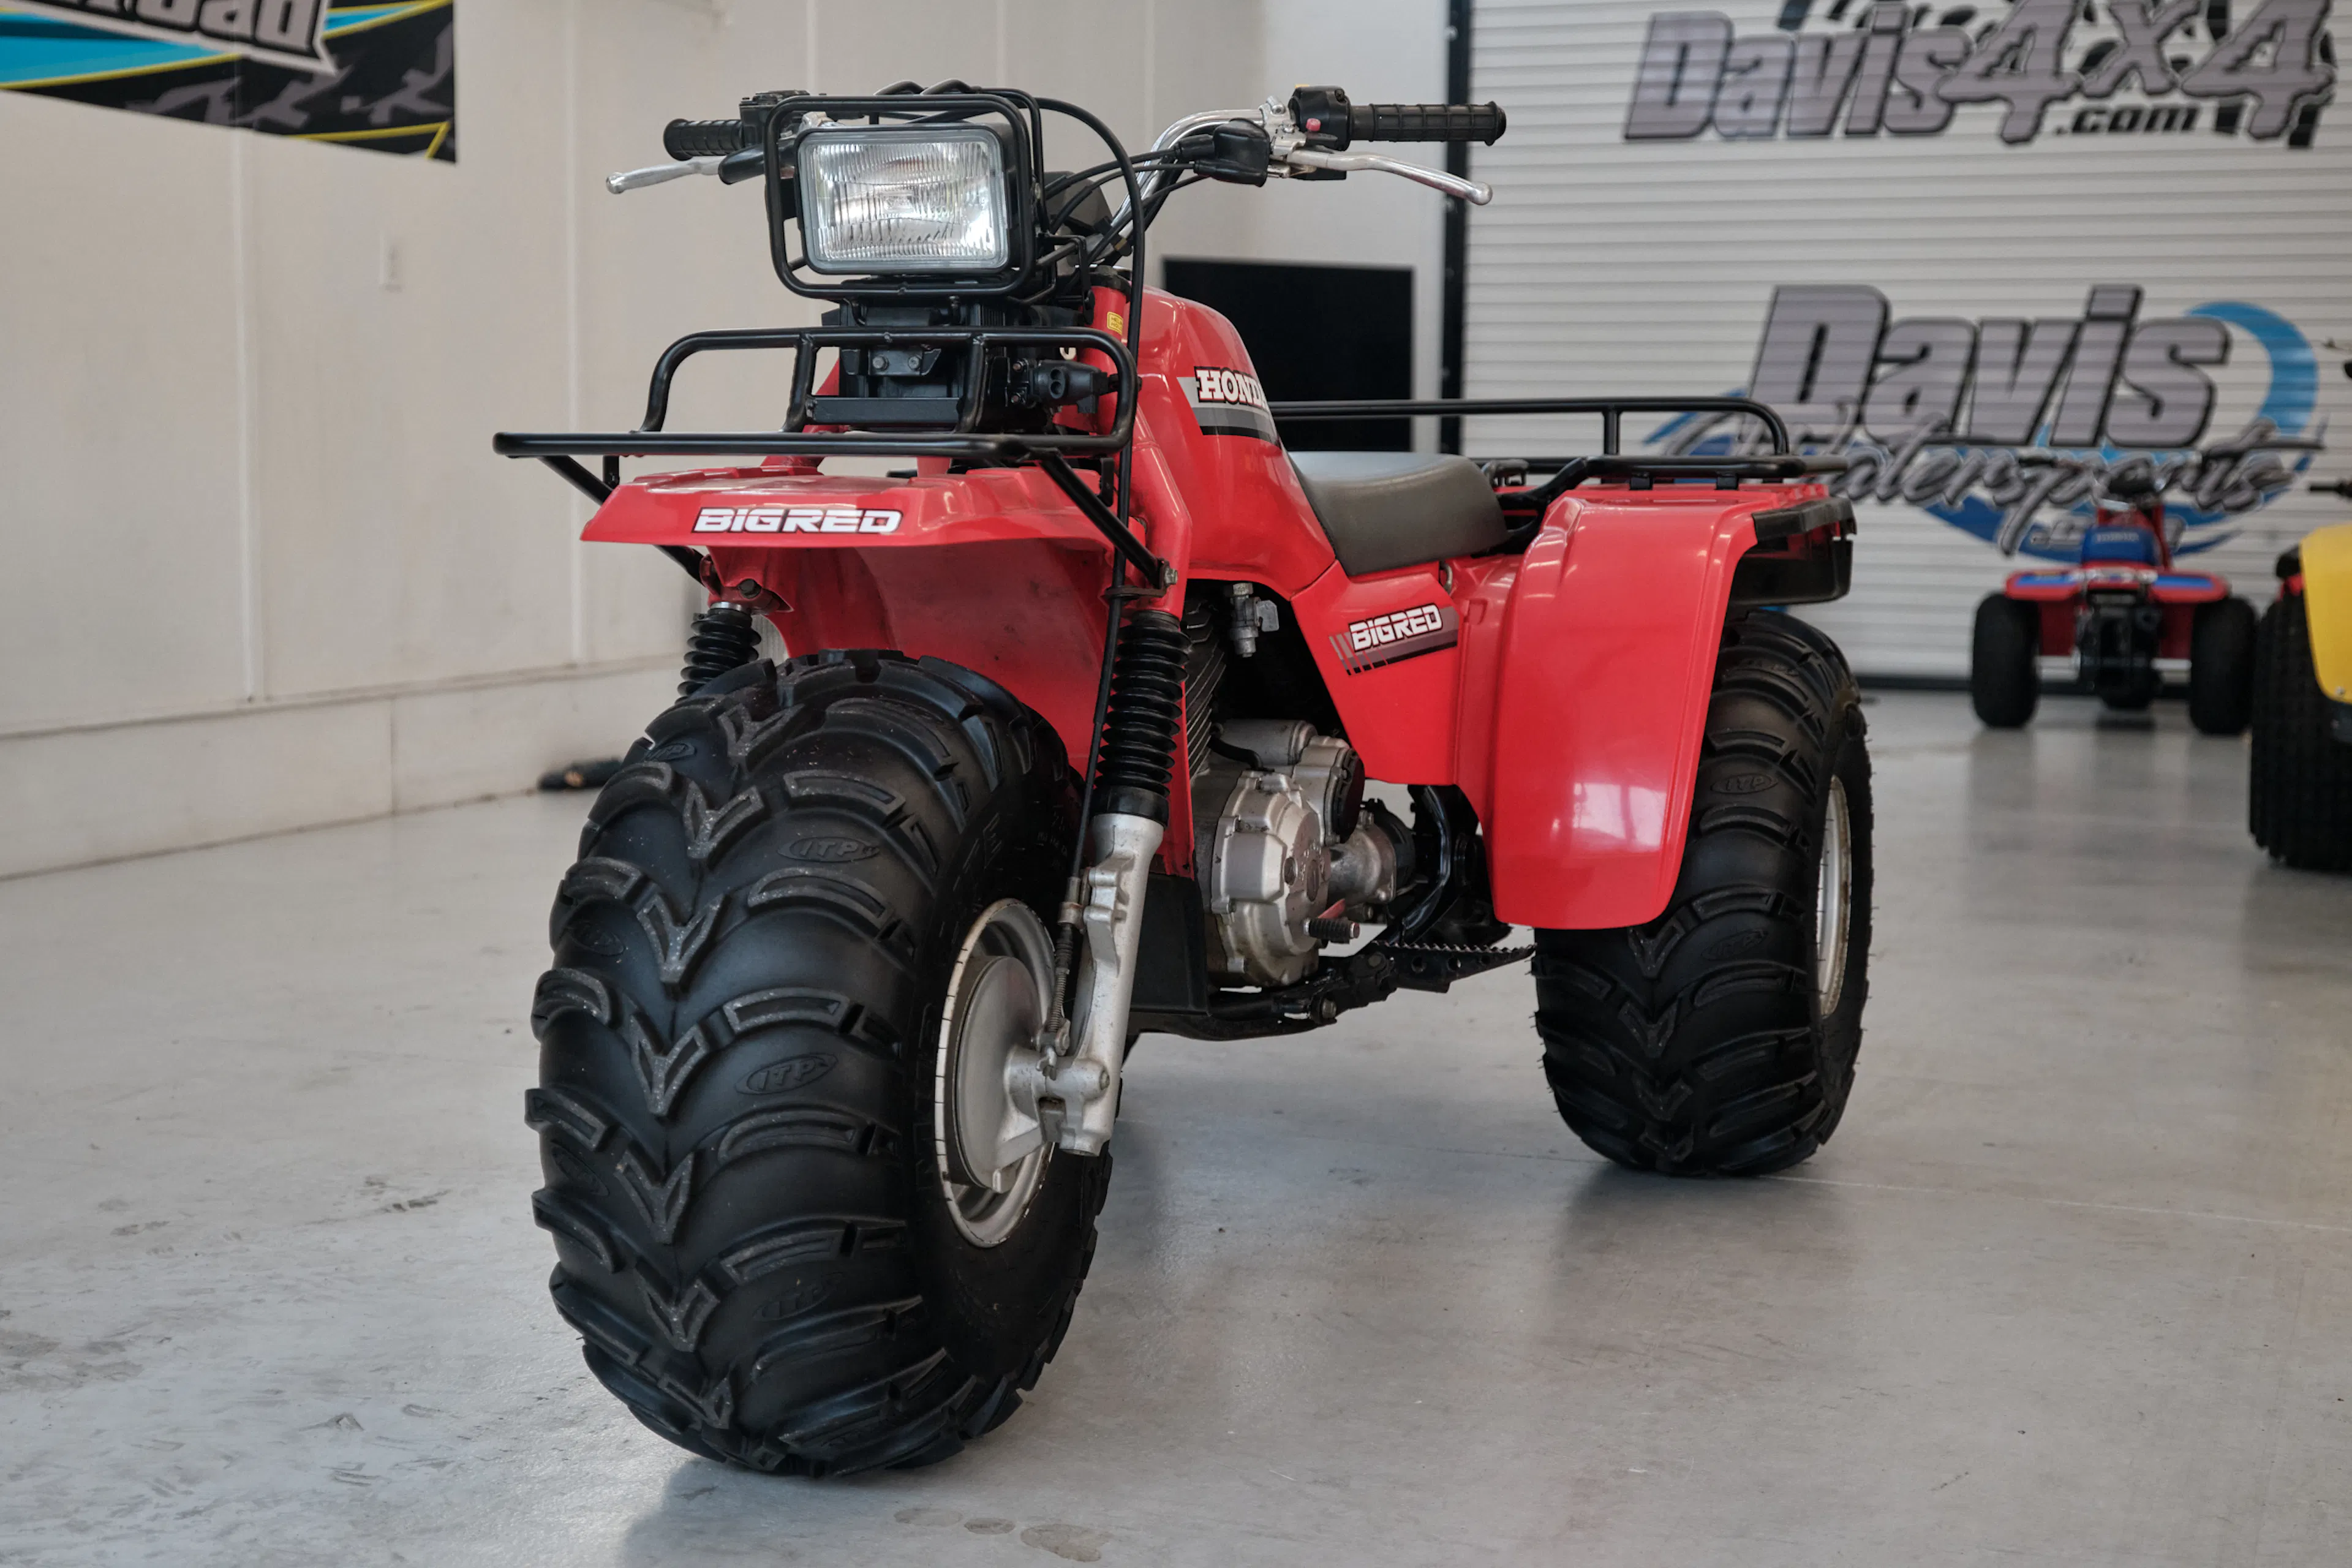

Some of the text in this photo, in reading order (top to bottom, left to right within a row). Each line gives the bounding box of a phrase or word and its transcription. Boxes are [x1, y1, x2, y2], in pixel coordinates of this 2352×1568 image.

[1738, 284, 2232, 449] Davis
[799, 840, 858, 856] ITP
[756, 1058, 816, 1090] ITP
